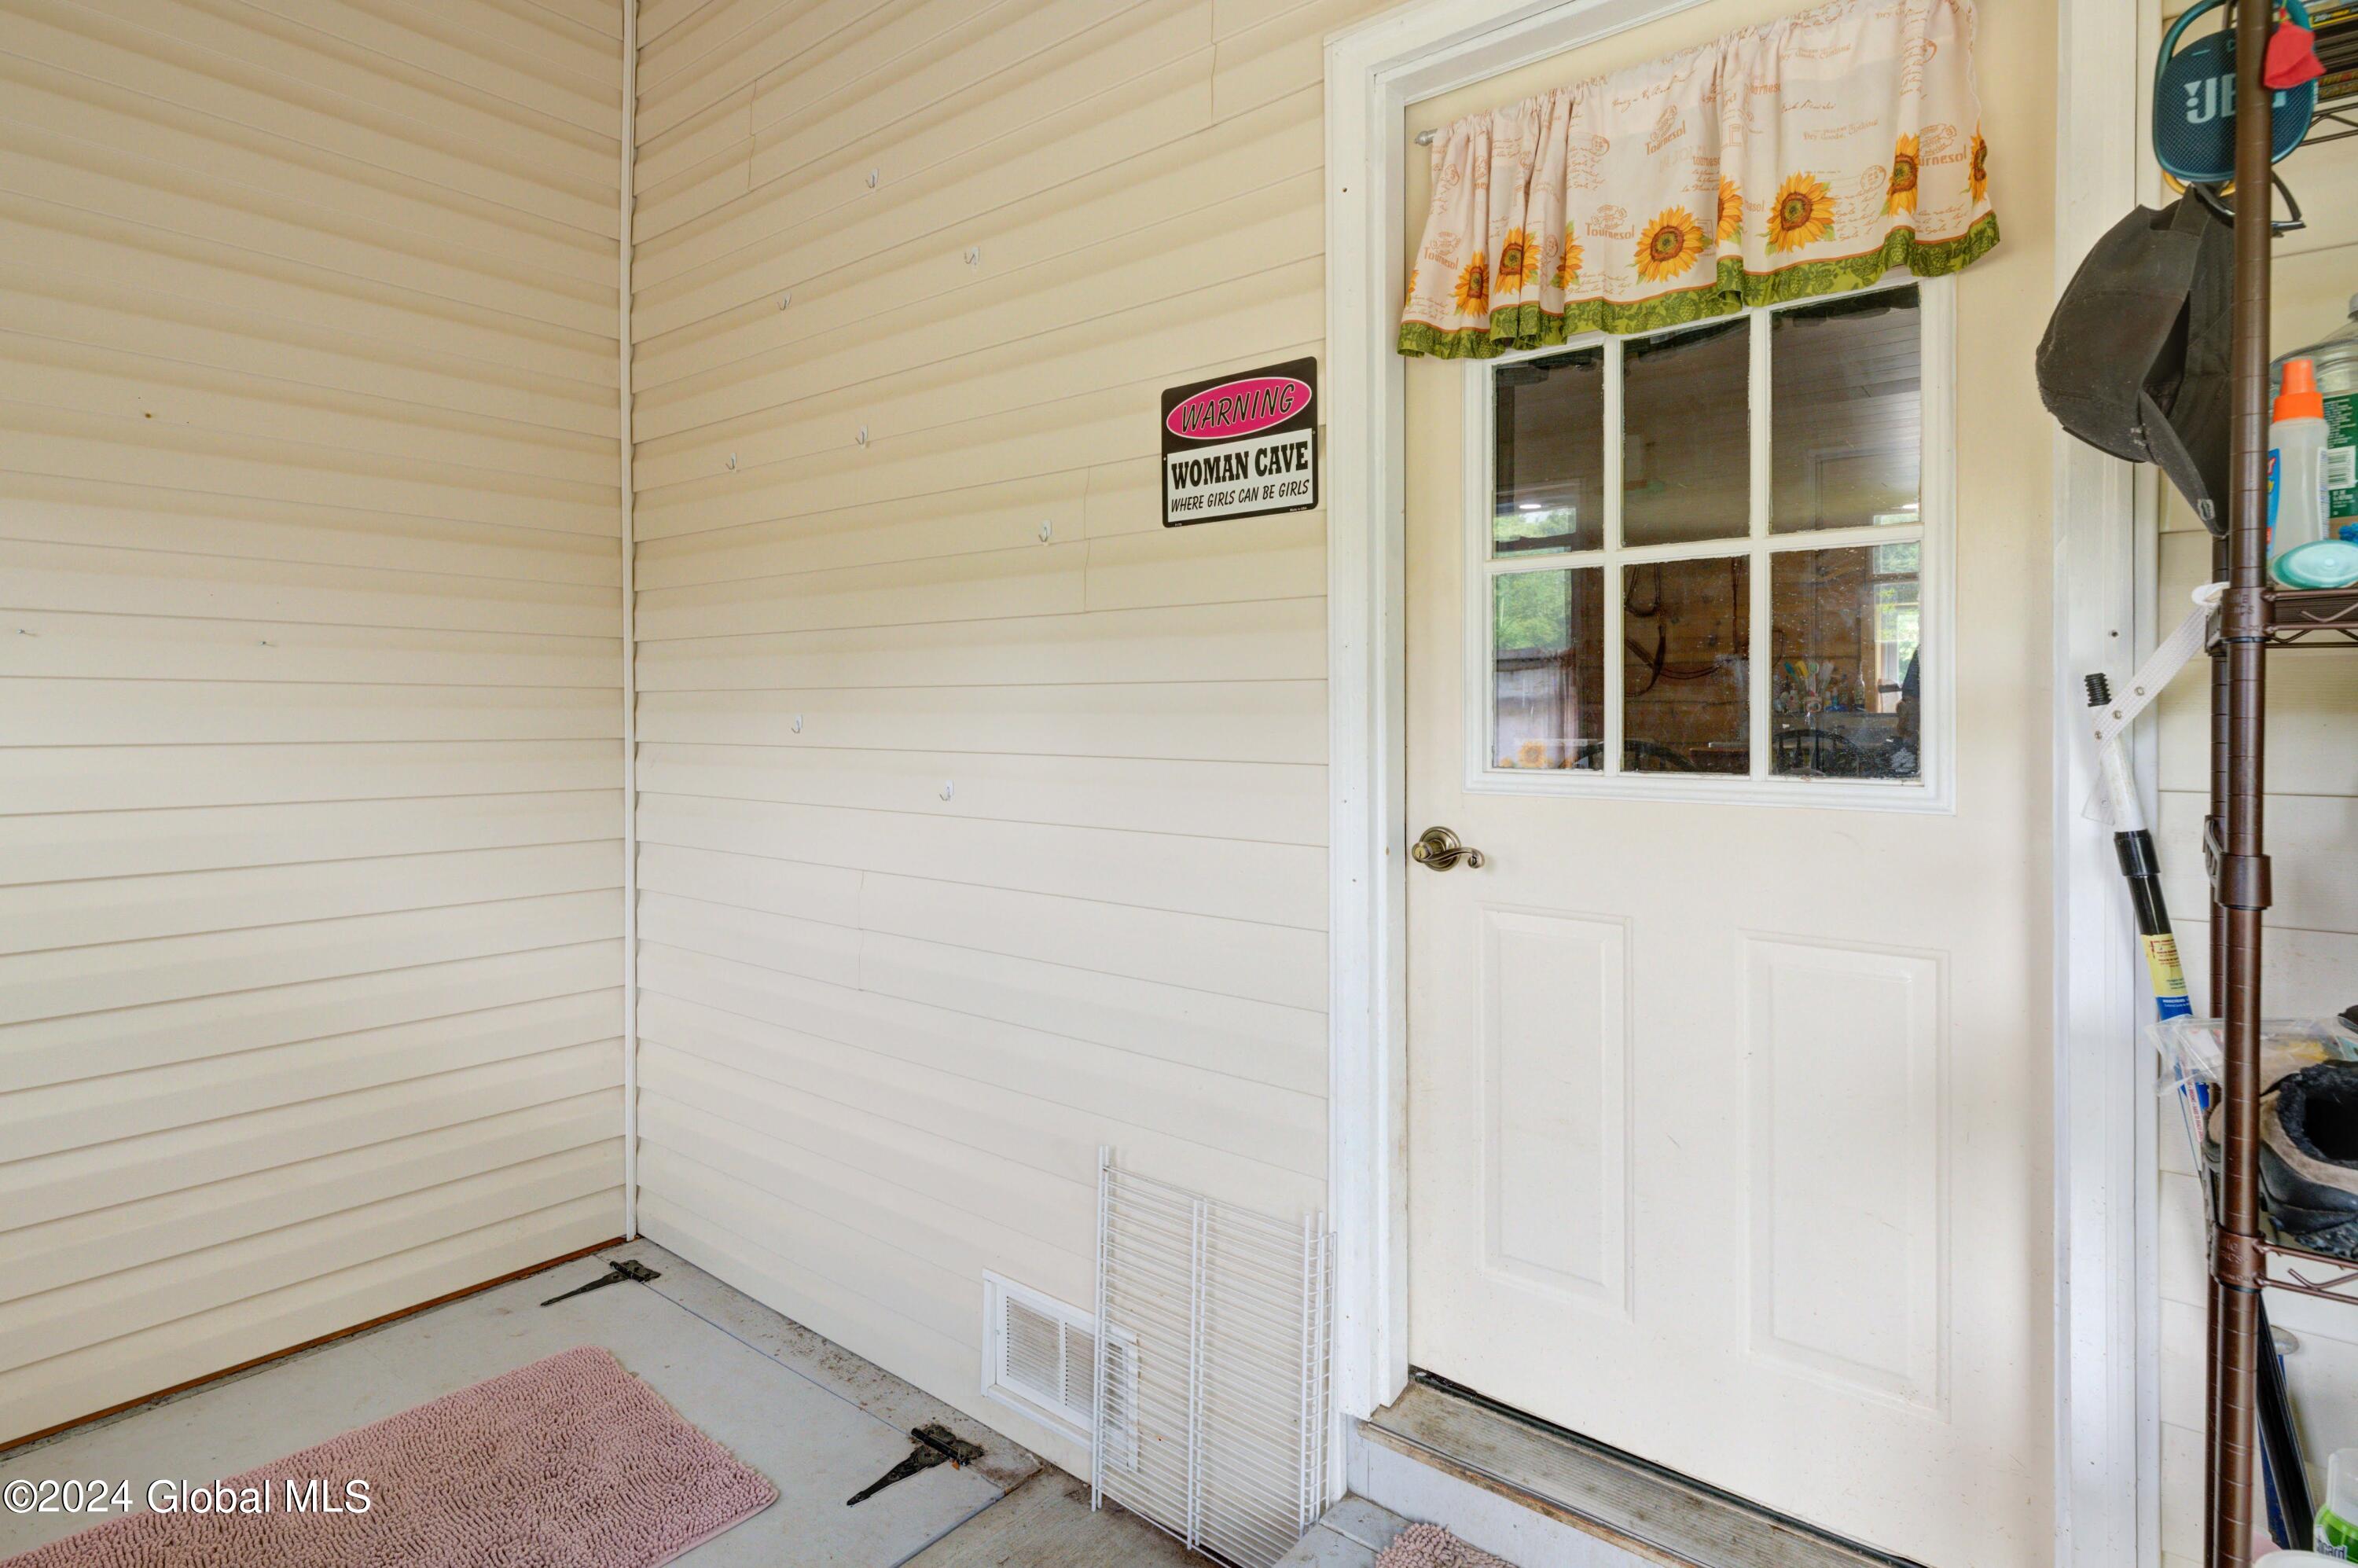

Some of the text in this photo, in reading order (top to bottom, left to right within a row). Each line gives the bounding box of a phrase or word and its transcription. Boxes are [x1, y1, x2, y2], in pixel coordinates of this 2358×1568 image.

[1645, 119, 1686, 156] Tournesol
[1919, 145, 1967, 166] urnesol
[1585, 222, 1636, 240] Tournesol
[1423, 246, 1460, 270] Tournesol
[1181, 383, 1295, 433] WARNING
[1171, 440, 1309, 490] WOMAN CAVE
[1171, 479, 1309, 512] WHERE GIRLS CAN BE GIRLS
